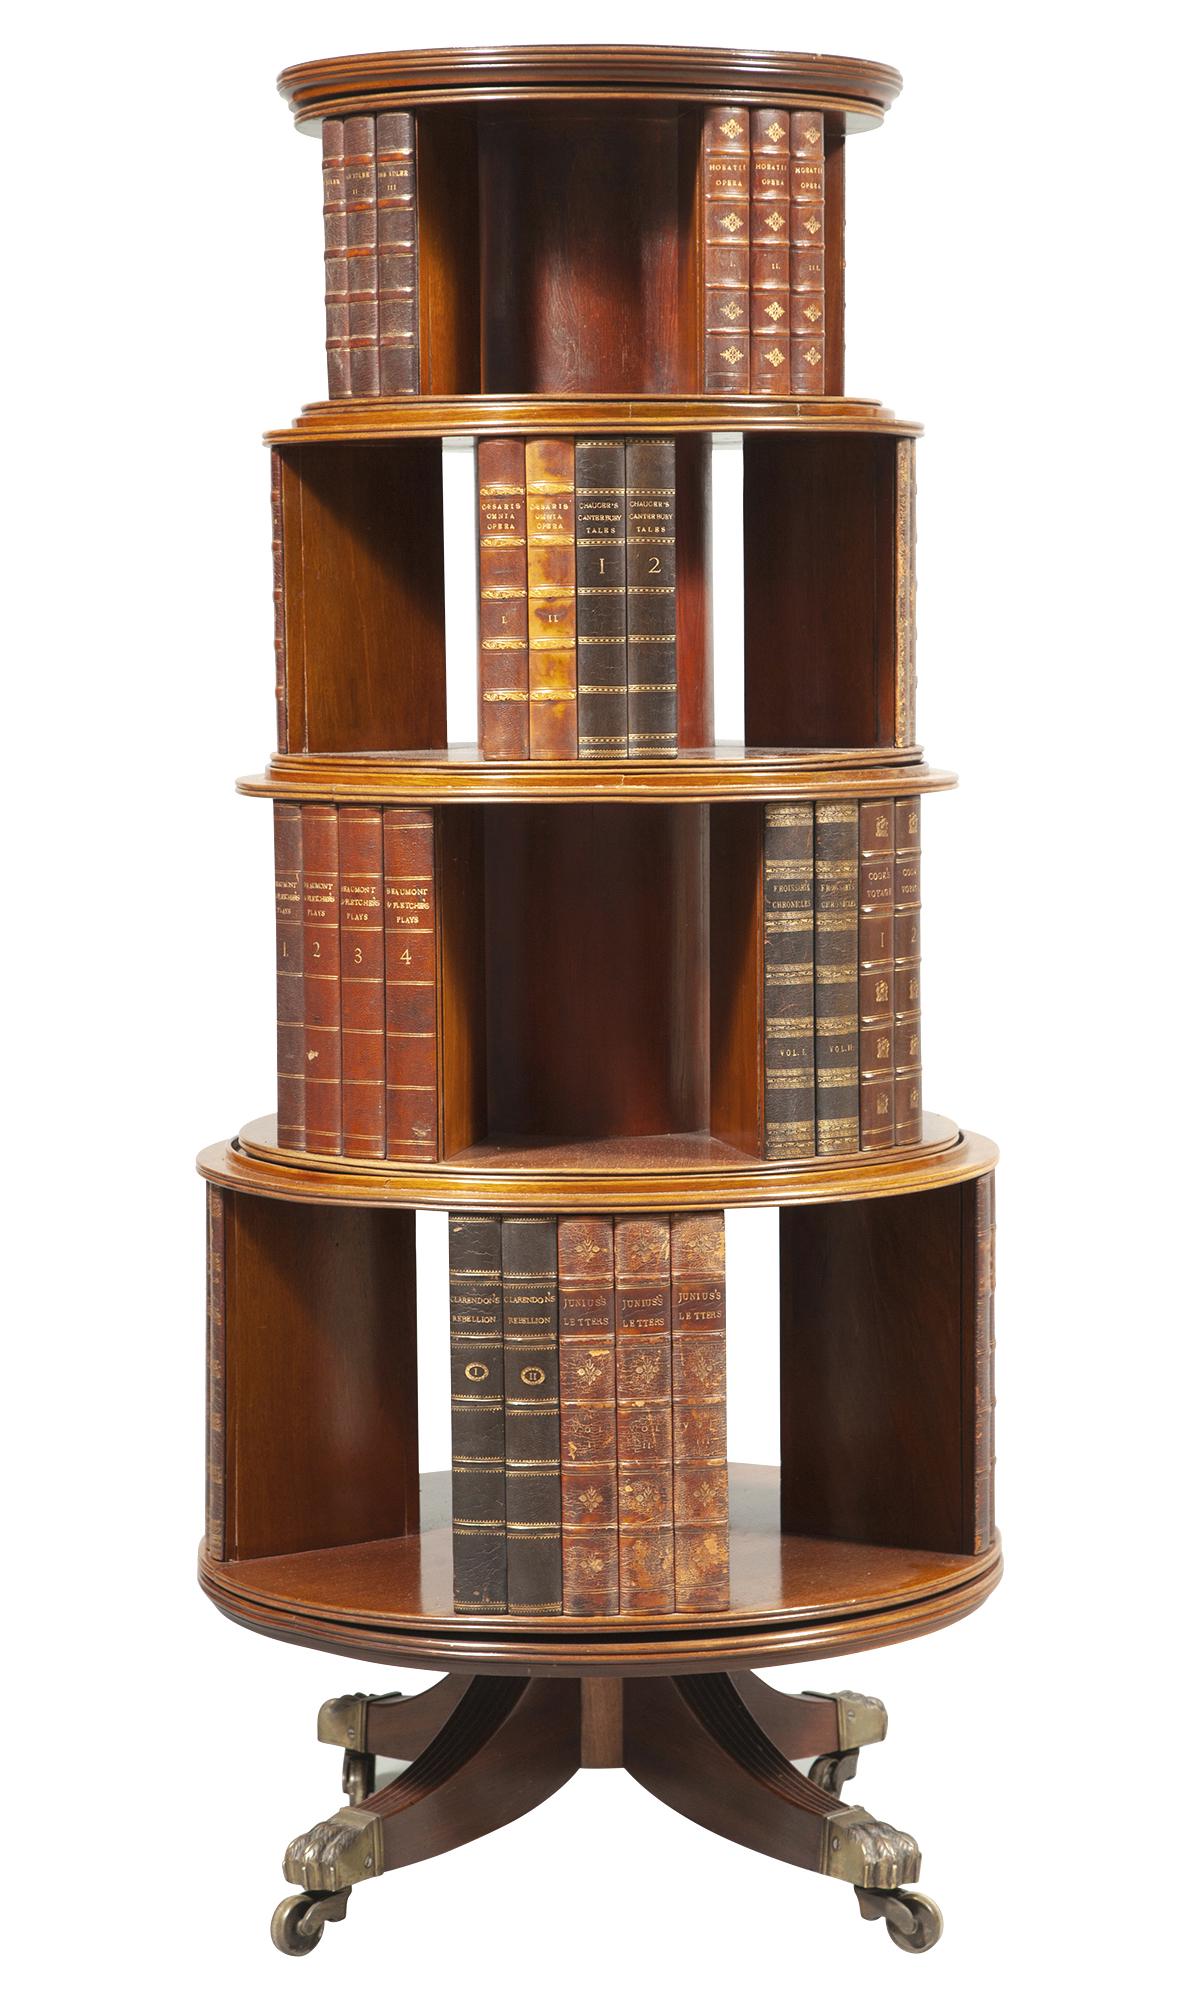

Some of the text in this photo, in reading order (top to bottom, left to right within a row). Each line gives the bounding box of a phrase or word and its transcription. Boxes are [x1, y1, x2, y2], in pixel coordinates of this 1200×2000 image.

[715, 179, 742, 187] OPERA
[648, 557, 662, 574] 2
[307, 909, 326, 917] PLAYS
[346, 913, 368, 921] PLAYS
[396, 916, 419, 924] PLAYS
[911, 927, 916, 943] 2
[312, 942, 320, 958] 2
[354, 948, 362, 964] 3
[400, 949, 412, 965] 4
[504, 1292, 555, 1304] CLARENDON'S
[678, 1289, 721, 1303] JUNIUS'S
[452, 1315, 496, 1323] REBELLION
[679, 1311, 722, 1321] LETTERS
[564, 1317, 609, 1326] LETTERS
[623, 1318, 665, 1327] LETTERS
[474, 1367, 478, 1376] I
